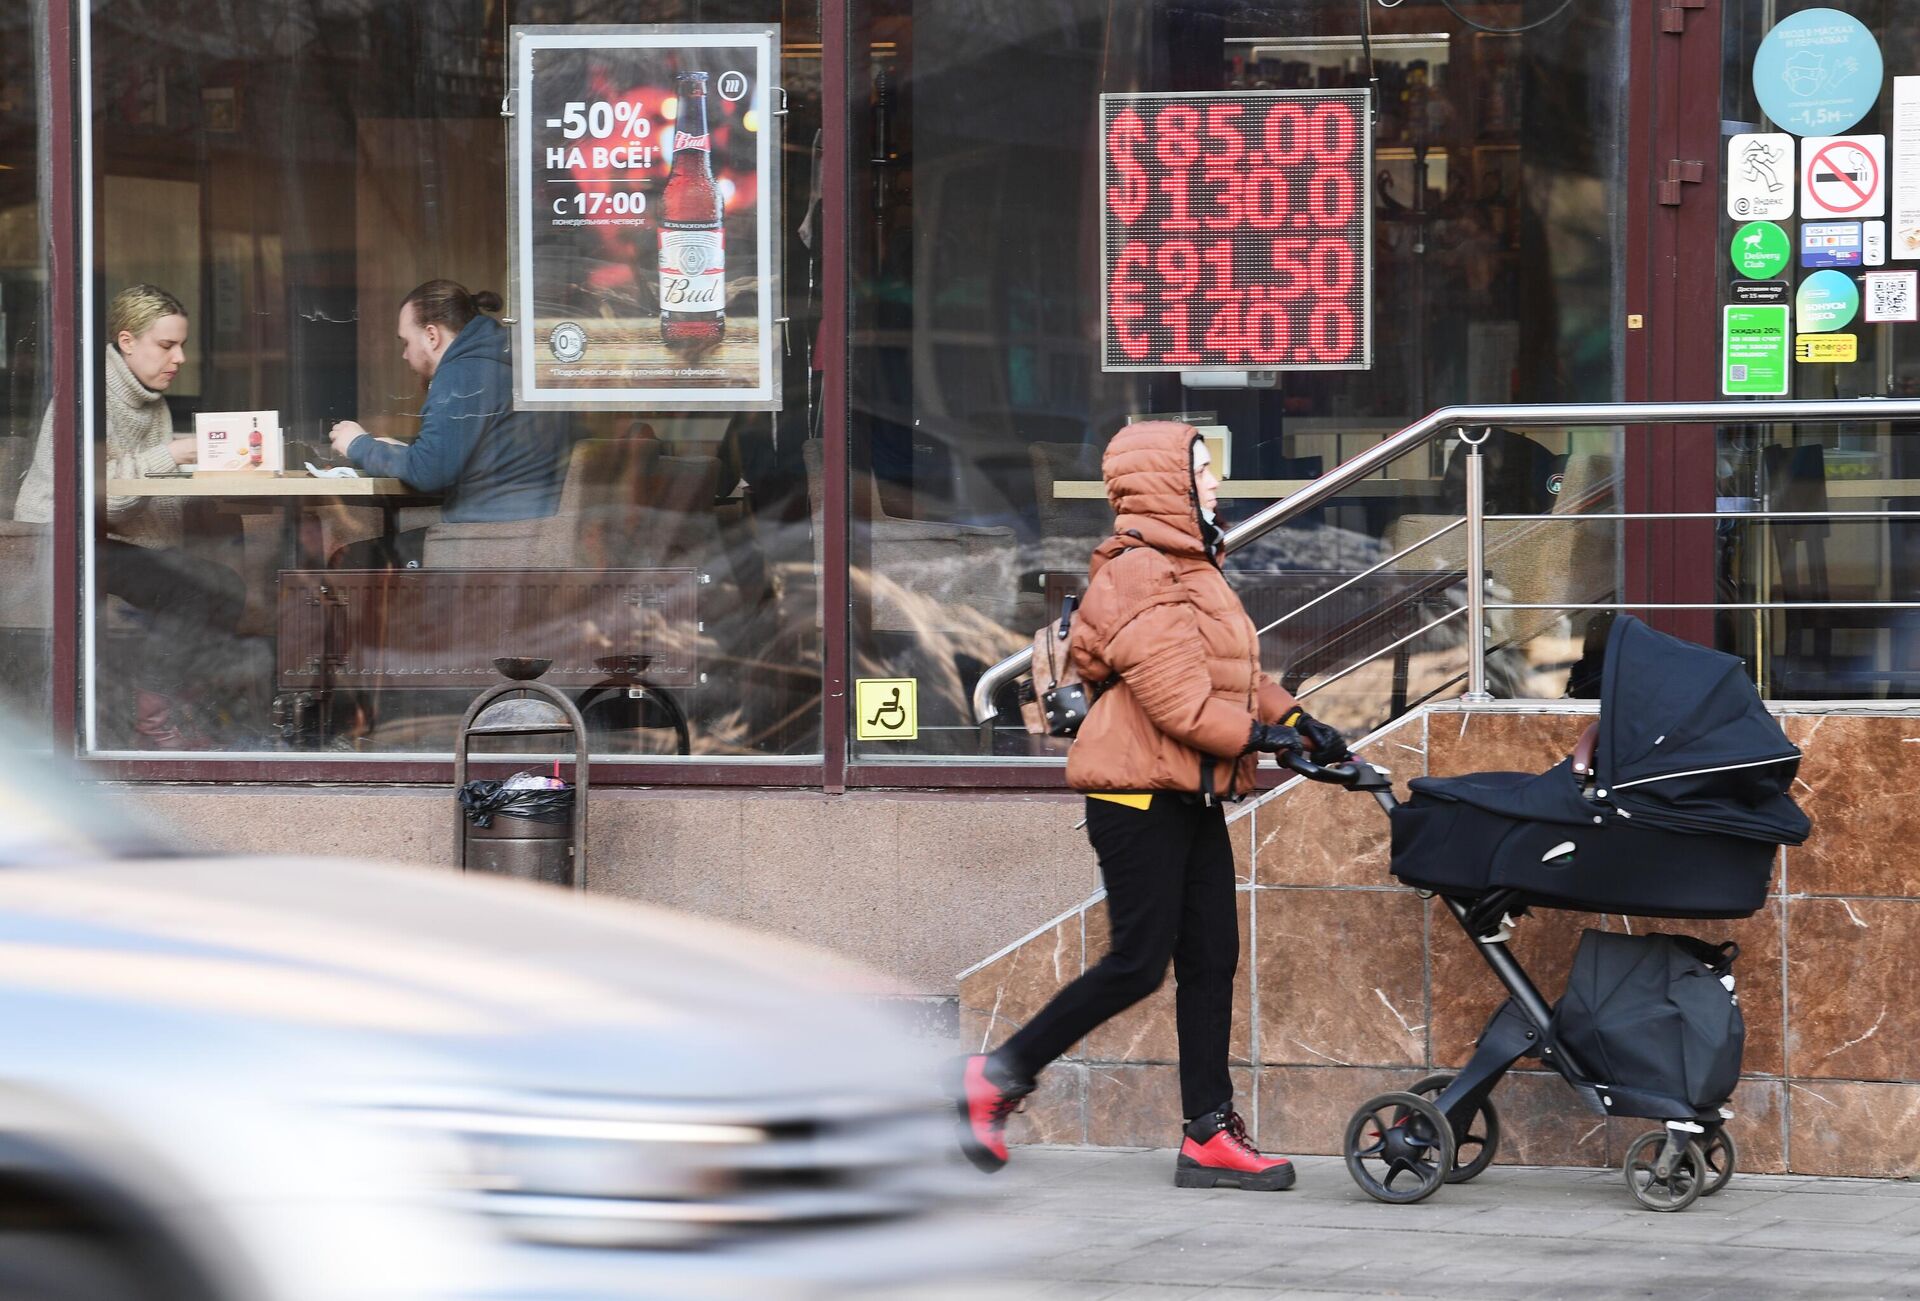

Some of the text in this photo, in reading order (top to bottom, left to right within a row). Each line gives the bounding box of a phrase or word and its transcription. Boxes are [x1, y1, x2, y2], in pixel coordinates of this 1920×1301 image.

[546, 101, 651, 139] -50%
[676, 131, 706, 149] Bud
[547, 147, 587, 169] НА
[573, 191, 647, 214] 17:00
[1753, 197, 1783, 206] Яндекс
[1753, 206, 1768, 215] Еда
[1744, 252, 1781, 261] Delivery
[1744, 260, 1766, 268] Club
[663, 277, 720, 304] Bud
[1161, 301, 1356, 363] 140.0
